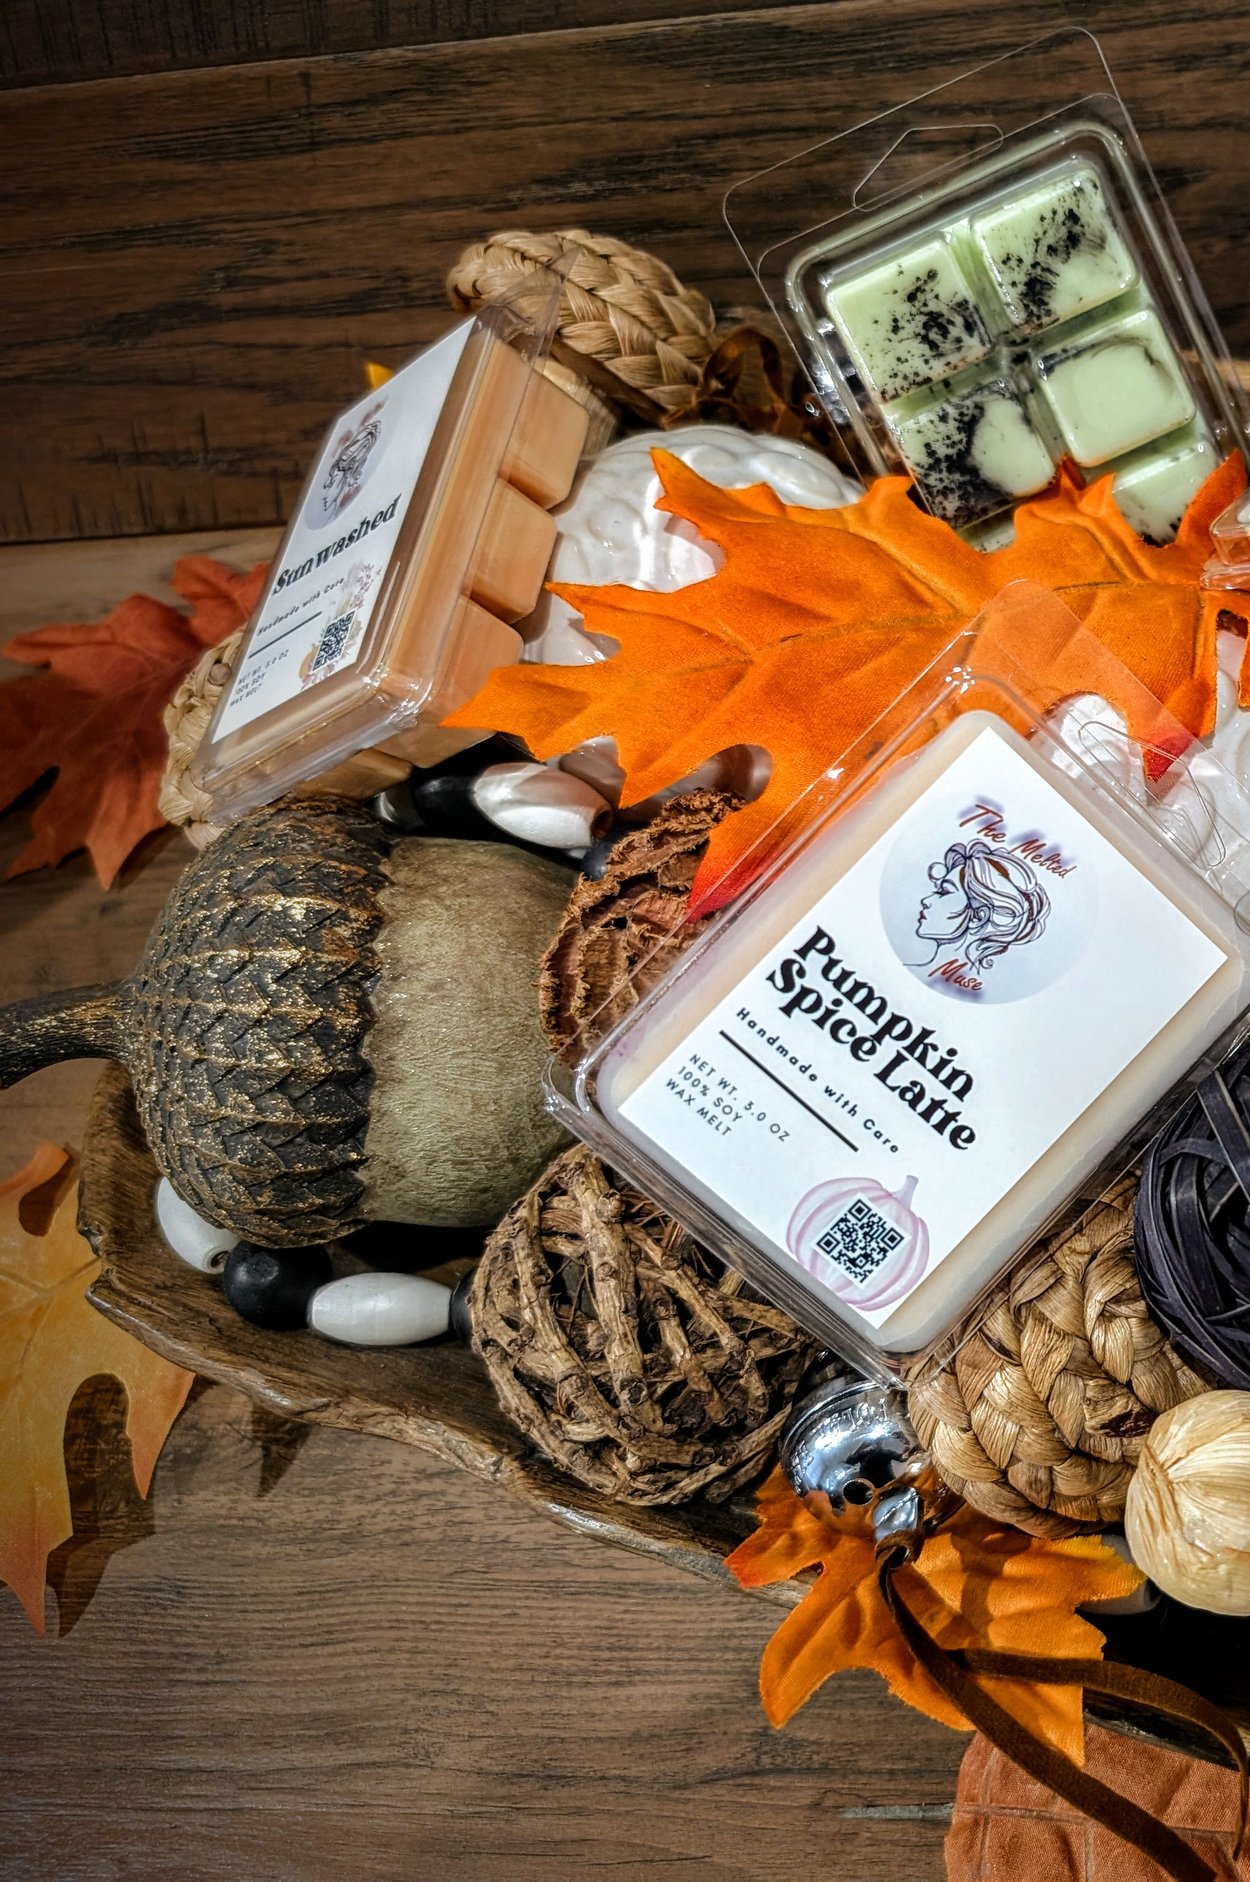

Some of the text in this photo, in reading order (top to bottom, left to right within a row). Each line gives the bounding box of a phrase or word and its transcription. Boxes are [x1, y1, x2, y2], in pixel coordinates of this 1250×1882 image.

[272, 492, 402, 596] Sunwashed
[959, 803, 1078, 879] The Melted
[793, 925, 974, 1103] Pumpkin
[928, 958, 983, 991] Muse
[678, 1065, 743, 1122] 100% SOY
[689, 1053, 790, 1142] NET WT. 3.0 OZ
[736, 1007, 899, 1154] Handmade with Care
[765, 957, 977, 1150] Spice Latte
[665, 1078, 732, 1136] WAX MELT
